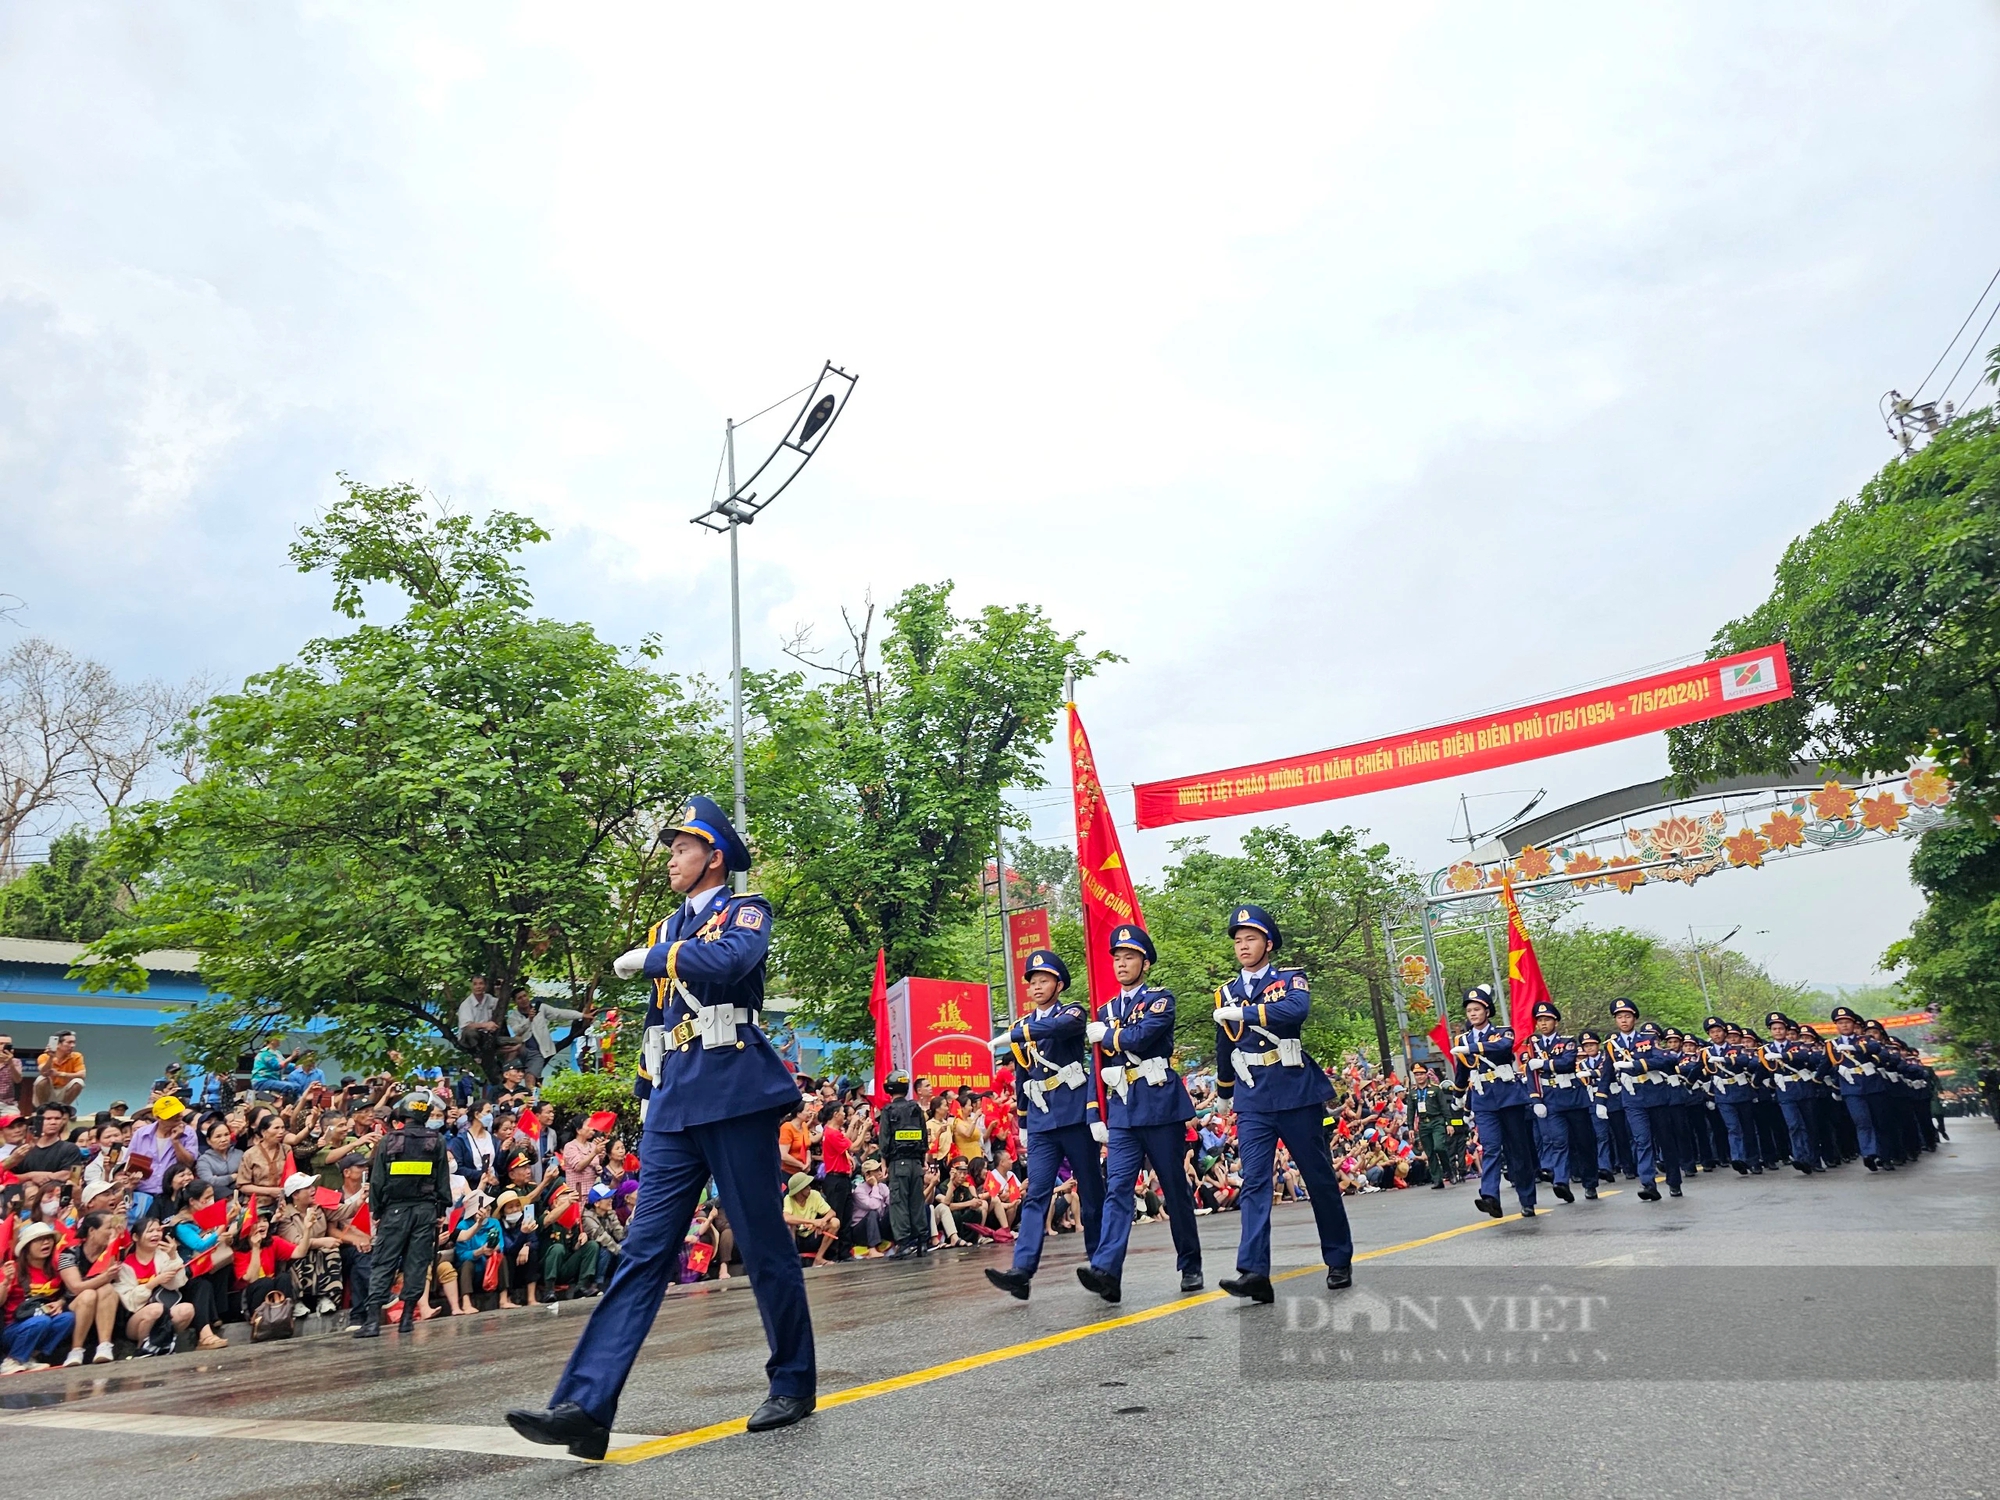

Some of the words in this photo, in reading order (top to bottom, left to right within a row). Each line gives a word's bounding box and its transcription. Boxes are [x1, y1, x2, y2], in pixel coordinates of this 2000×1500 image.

[1178, 783, 1209, 806] NHIỆT
[1211, 778, 1233, 803] LIỆT
[1235, 773, 1266, 797] CHÀO
[1268, 767, 1304, 792] MỪNG
[1306, 764, 1322, 785] 70
[1323, 756, 1353, 782] NĂM
[1355, 746, 1394, 776] CHIẾN
[1396, 739, 1440, 768] THẮNG
[1441, 730, 1475, 758] ĐIỆN
[1477, 722, 1511, 751] BIÊN
[1513, 712, 1543, 743] PHỦ
[1545, 700, 1616, 737] (7/5/1954
[1628, 676, 1711, 716] 7/5/2024)!
[934, 1051, 956, 1070] NHIỆT
[956, 1051, 972, 1070] LIỆT
[973, 1072, 991, 1088] NĂM
